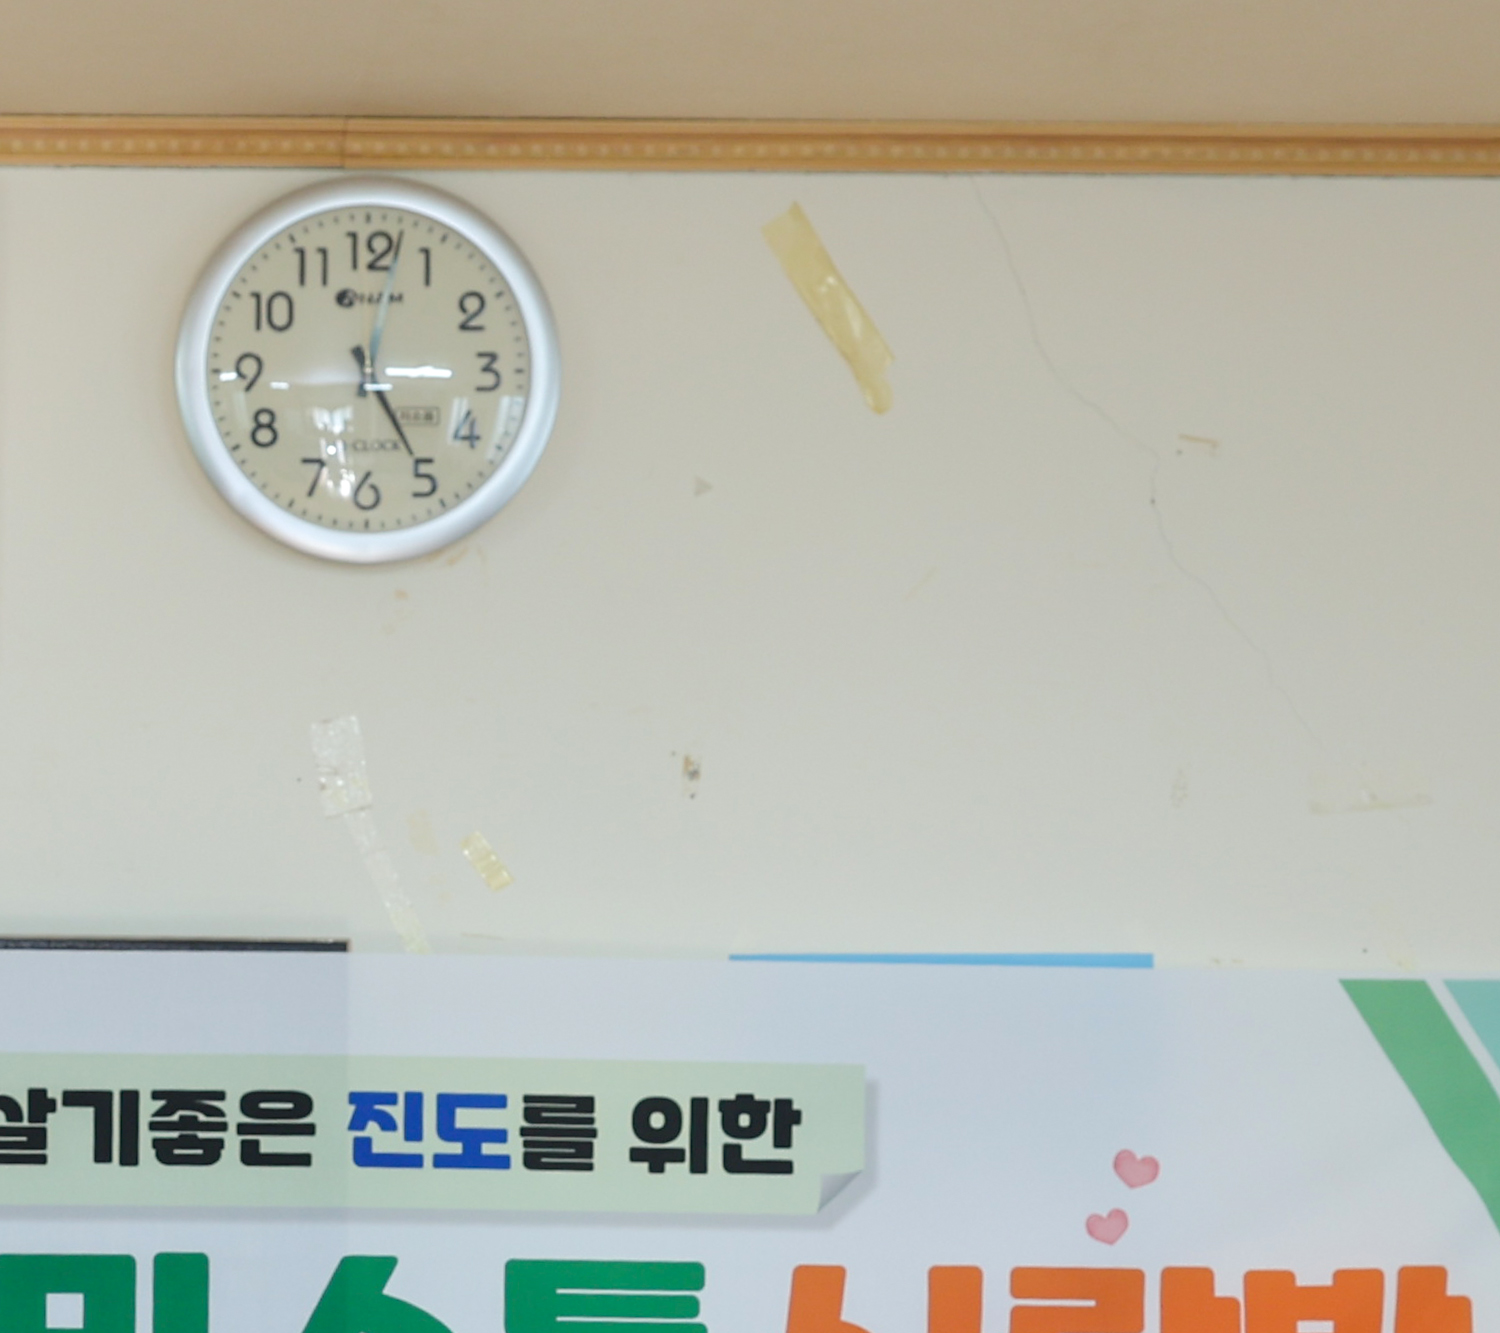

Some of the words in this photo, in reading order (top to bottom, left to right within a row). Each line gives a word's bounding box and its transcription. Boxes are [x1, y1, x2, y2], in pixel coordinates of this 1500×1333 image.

[294, 247, 329, 286] 11
[346, 231, 393, 271] 12
[418, 247, 432, 287] 1
[250, 291, 294, 332] 10
[458, 291, 485, 332] 2
[235, 352, 264, 392] 9
[476, 352, 501, 391] 3
[251, 408, 278, 447] 8
[301, 458, 326, 497] 7
[354, 471, 381, 510] 6
[412, 457, 437, 497] 5
[347, 1090, 597, 1172] 진도를
[629, 1093, 802, 1175] 위한
